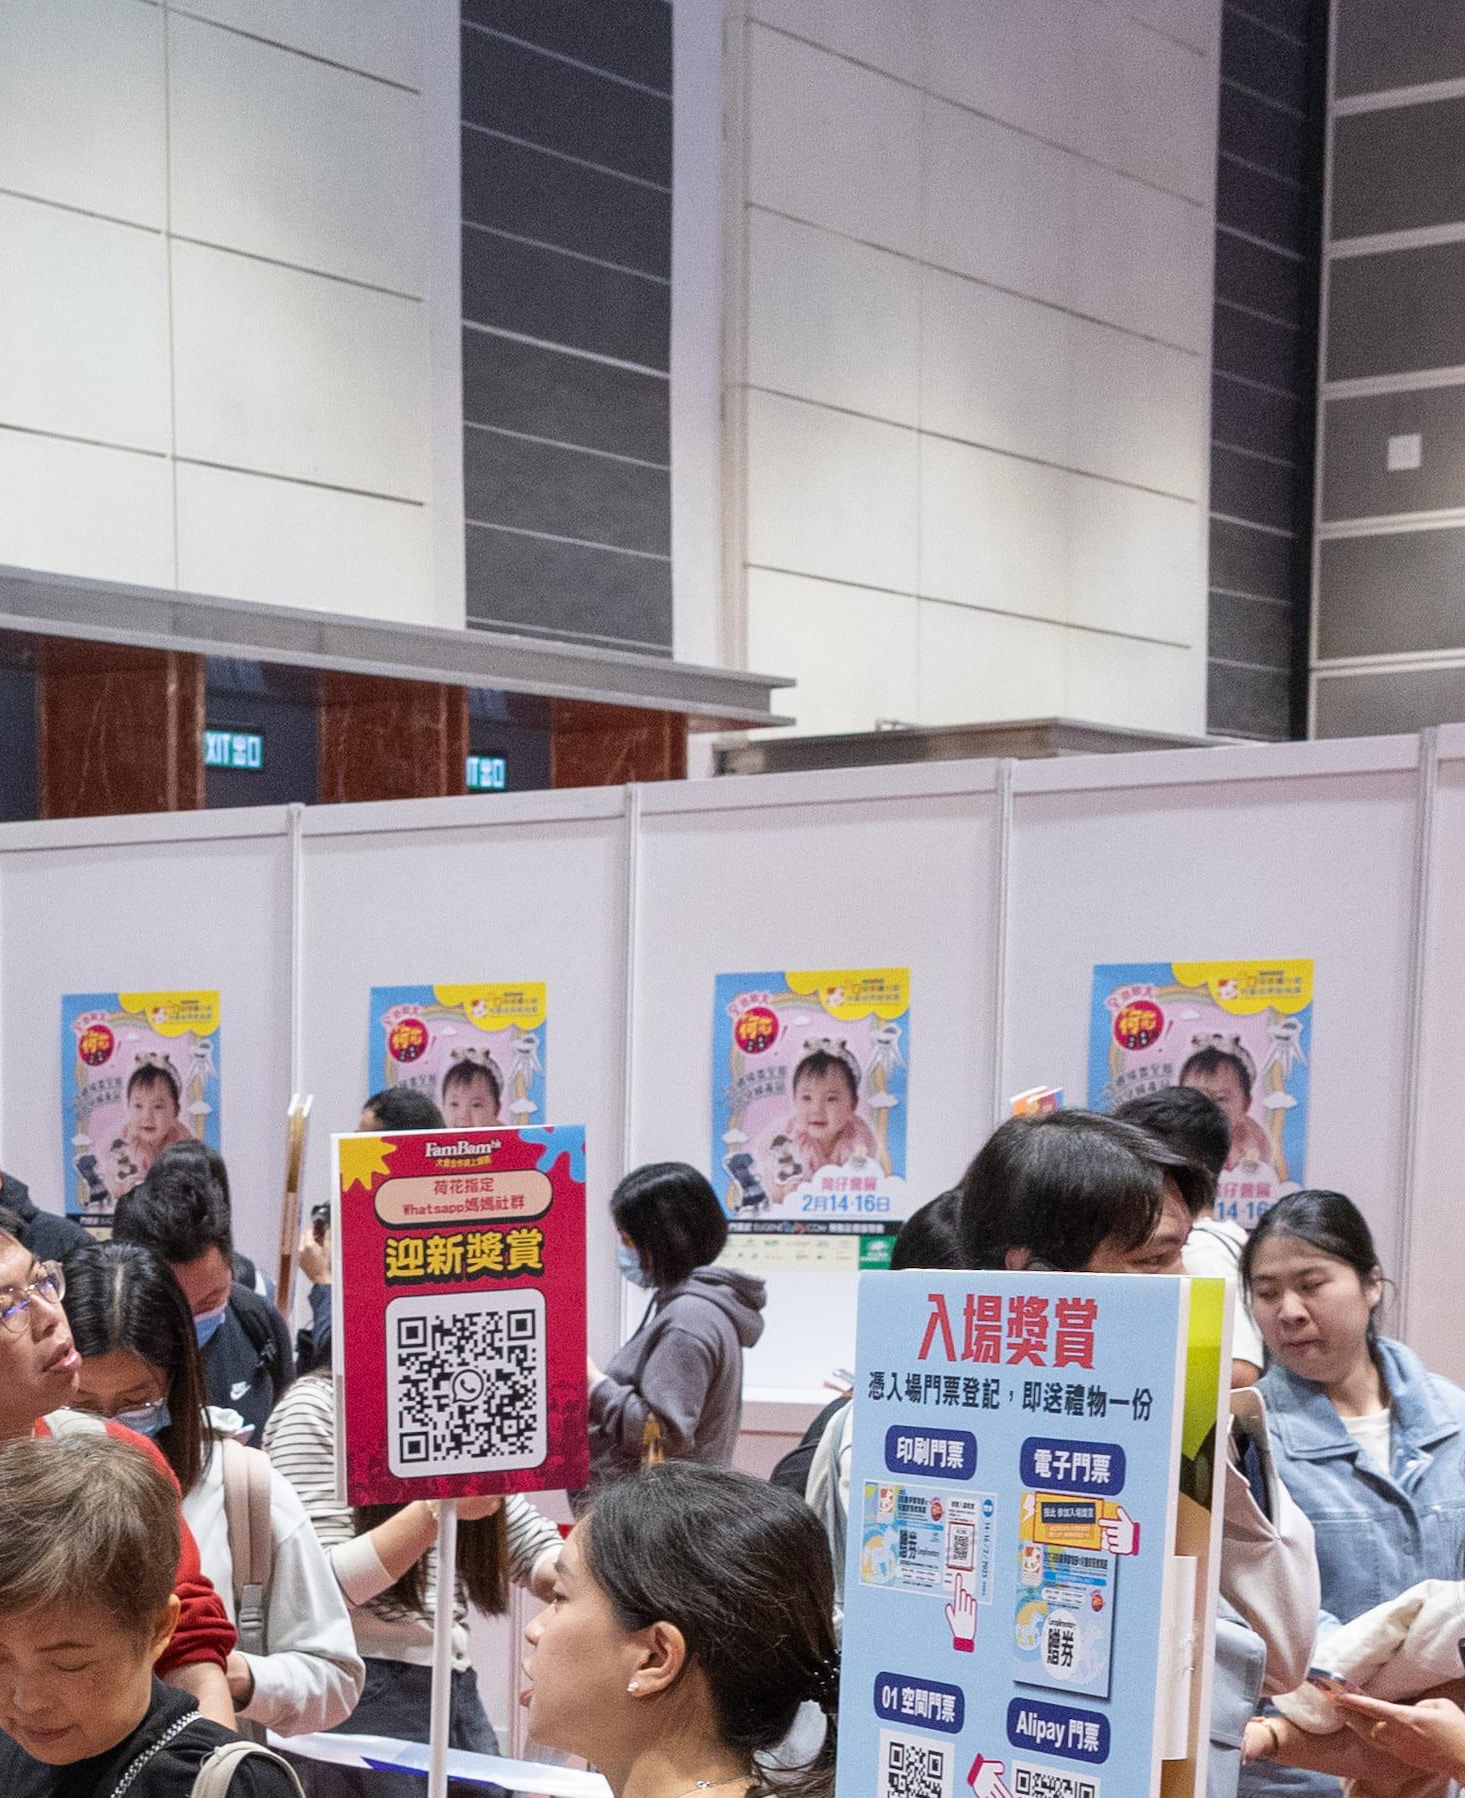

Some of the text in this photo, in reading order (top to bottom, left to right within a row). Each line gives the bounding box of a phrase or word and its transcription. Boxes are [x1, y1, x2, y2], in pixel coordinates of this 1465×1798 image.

[433, 1177, 495, 1195] 荷花指定
[385, 1228, 545, 1279] 迎新獎賞
[917, 1292, 1099, 1370] 入場獎賞
[896, 1435, 965, 1471] 印刷門票
[1034, 1448, 1112, 1484] 電子門票
[1046, 1628, 1074, 1667] 贈券
[881, 1685, 956, 1724] 01 空間門票
[1015, 1710, 1101, 1752] Alipay 門票
